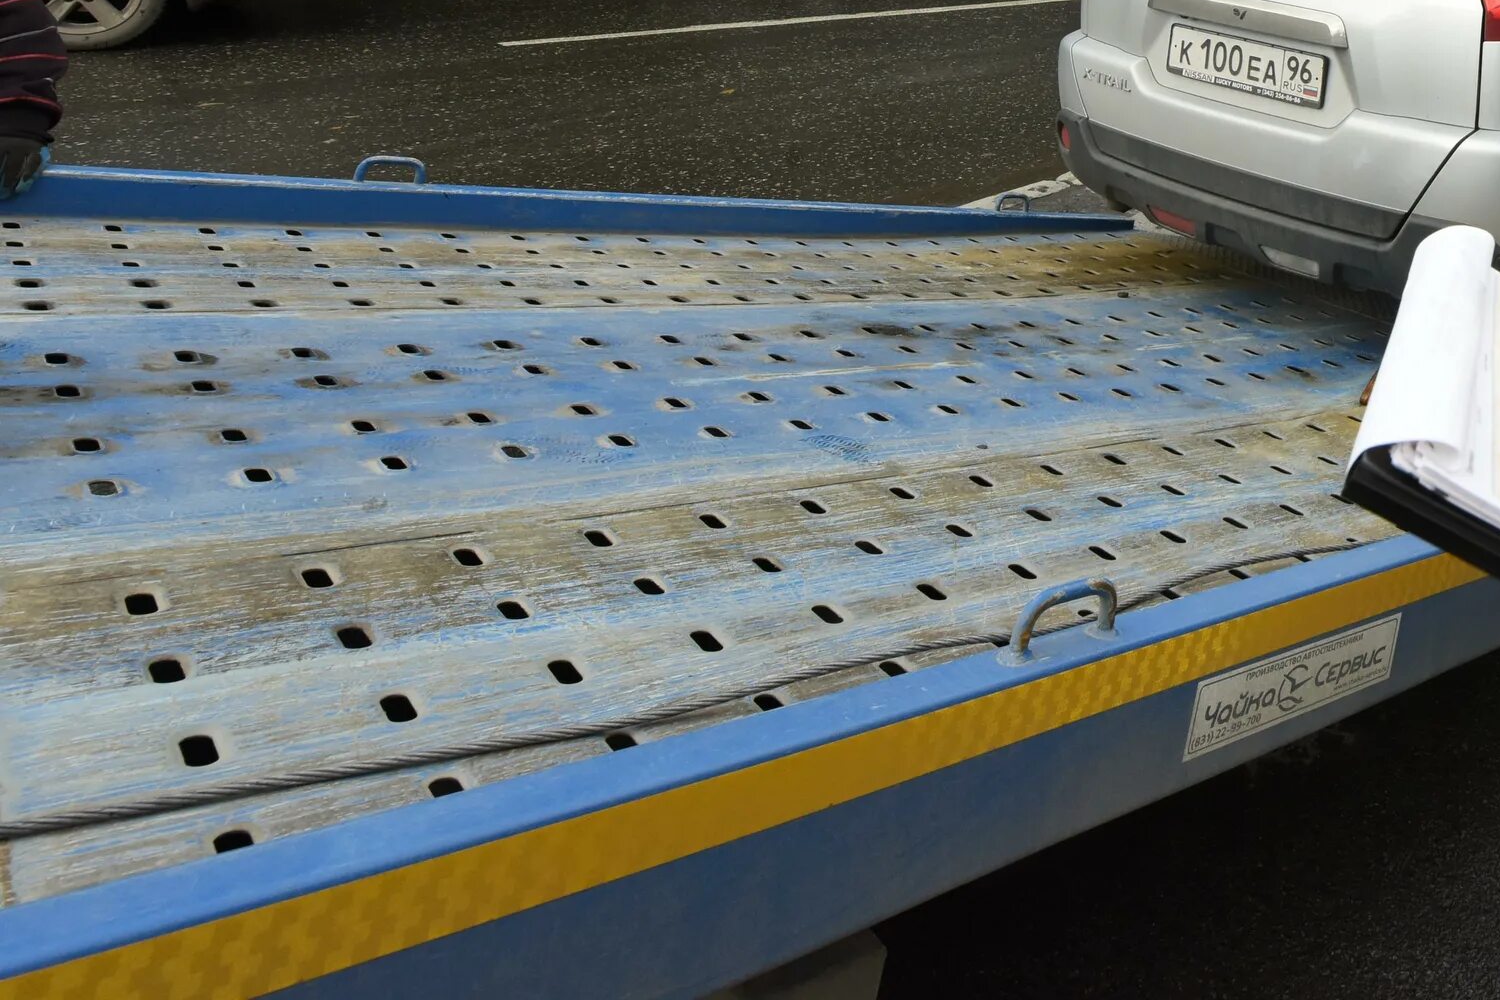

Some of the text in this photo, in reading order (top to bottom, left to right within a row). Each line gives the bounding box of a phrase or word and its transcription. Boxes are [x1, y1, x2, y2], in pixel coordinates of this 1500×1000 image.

[1184, 69, 1213, 82] NISSAN
[1282, 80, 1303, 93] RUS
[1245, 655, 1301, 681] ПРОИЗВОДСТВО
[1190, 712, 1262, 751] (831) 22-99-700
